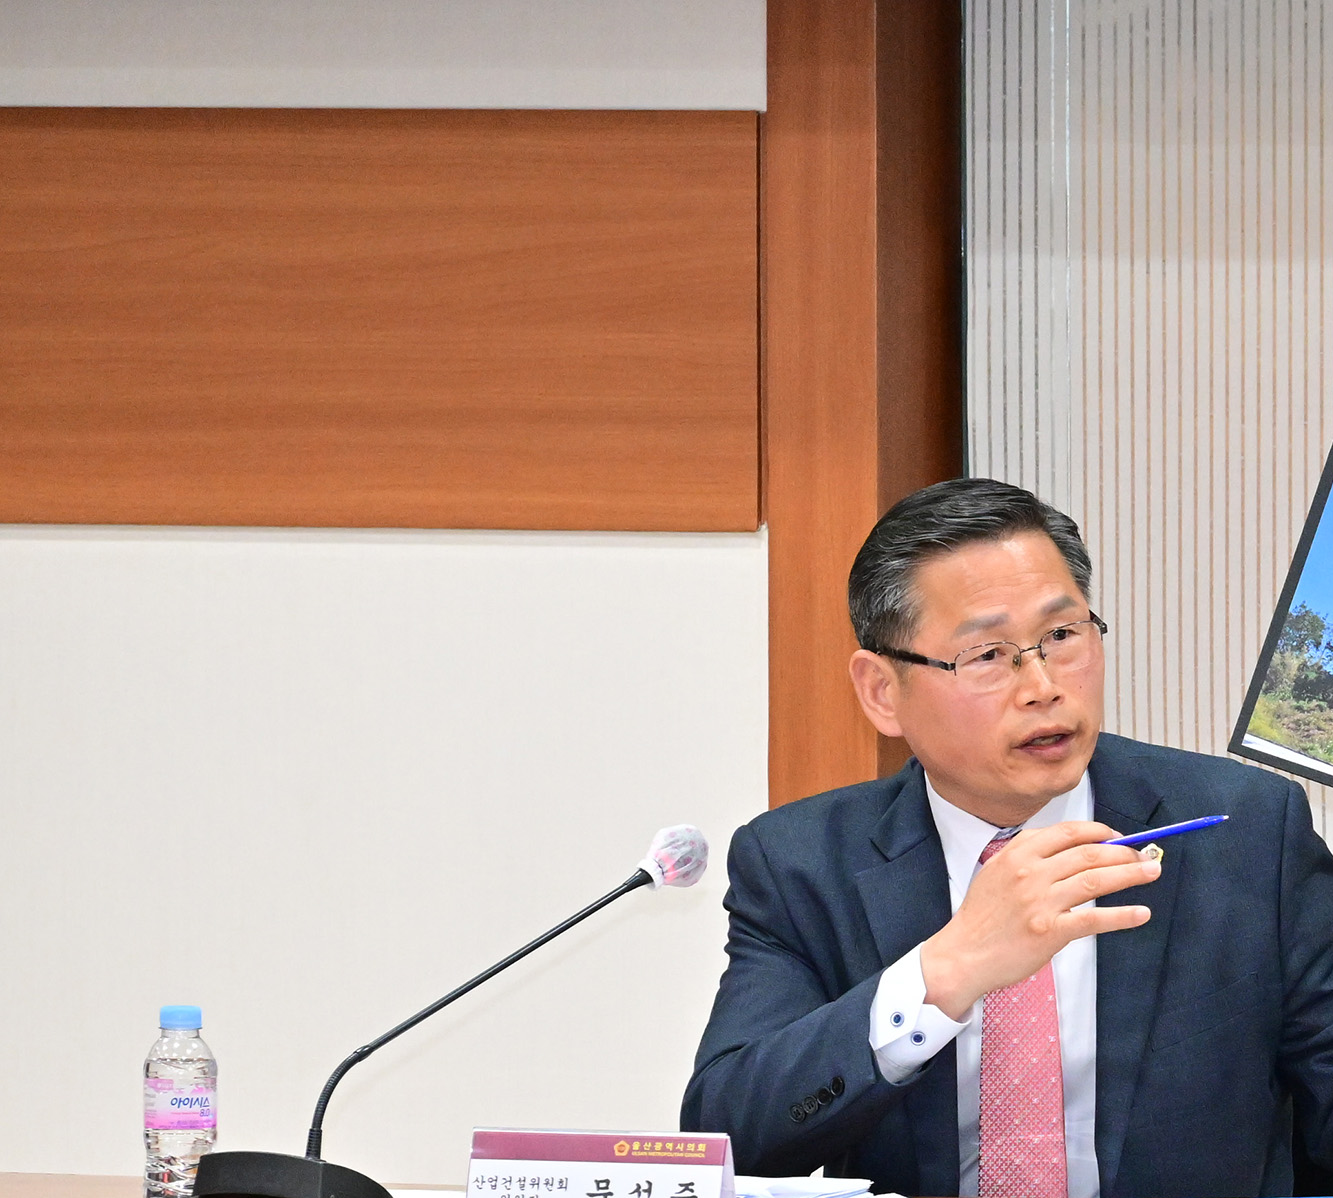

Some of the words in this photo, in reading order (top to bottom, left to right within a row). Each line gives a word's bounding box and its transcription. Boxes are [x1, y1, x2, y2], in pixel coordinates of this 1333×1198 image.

[170, 1096, 210, 1109] 아이시스
[632, 1141, 707, 1153] 울산광역시의회
[472, 1174, 569, 1193] 산업건설위원회
